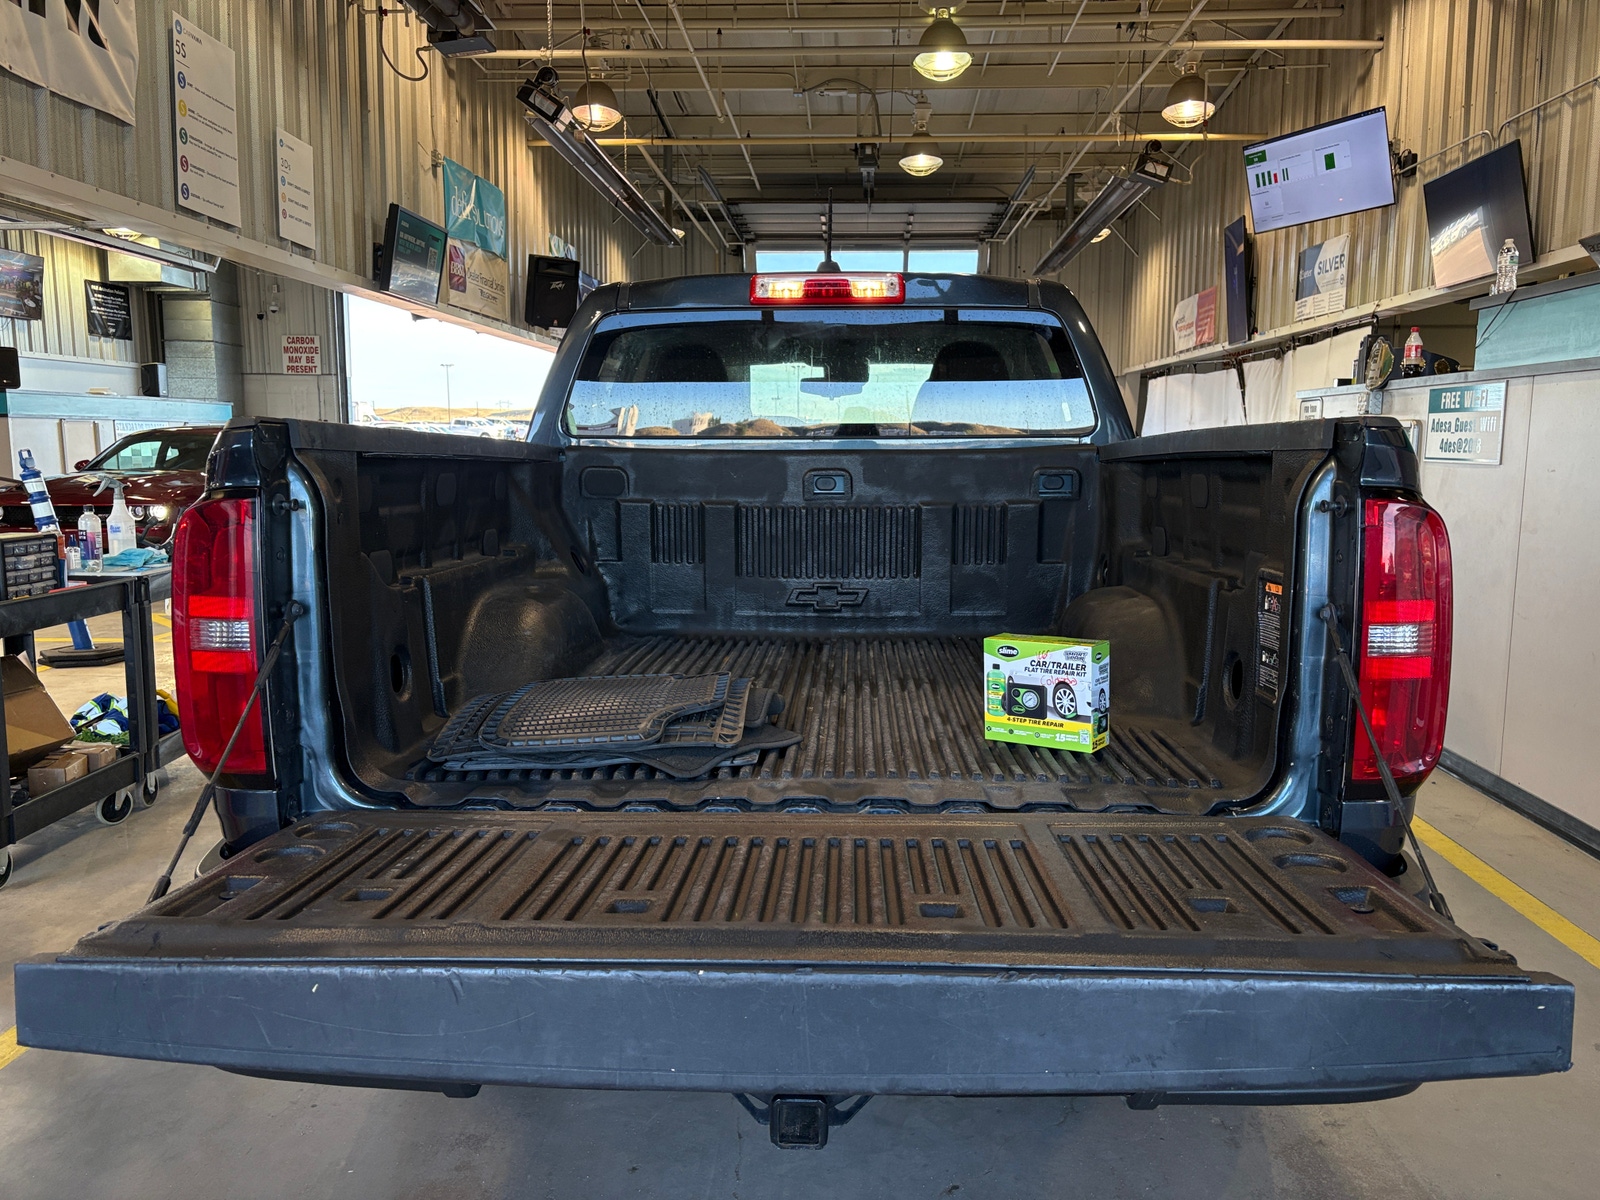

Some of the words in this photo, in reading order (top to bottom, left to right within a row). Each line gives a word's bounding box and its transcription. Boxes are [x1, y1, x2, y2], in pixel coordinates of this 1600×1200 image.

[175, 39, 186, 58] 5S
[1317, 254, 1345, 275] SILVER
[286, 336, 315, 344] CARBON
[283, 346, 319, 354] MONOXIDE
[1441, 392, 1461, 409] FREE
[1439, 438, 1482, 454] 4des@208
[999, 647, 1017, 655] slime
[1030, 660, 1086, 671] CAR/TRAILER
[1055, 734, 1065, 742] 15
